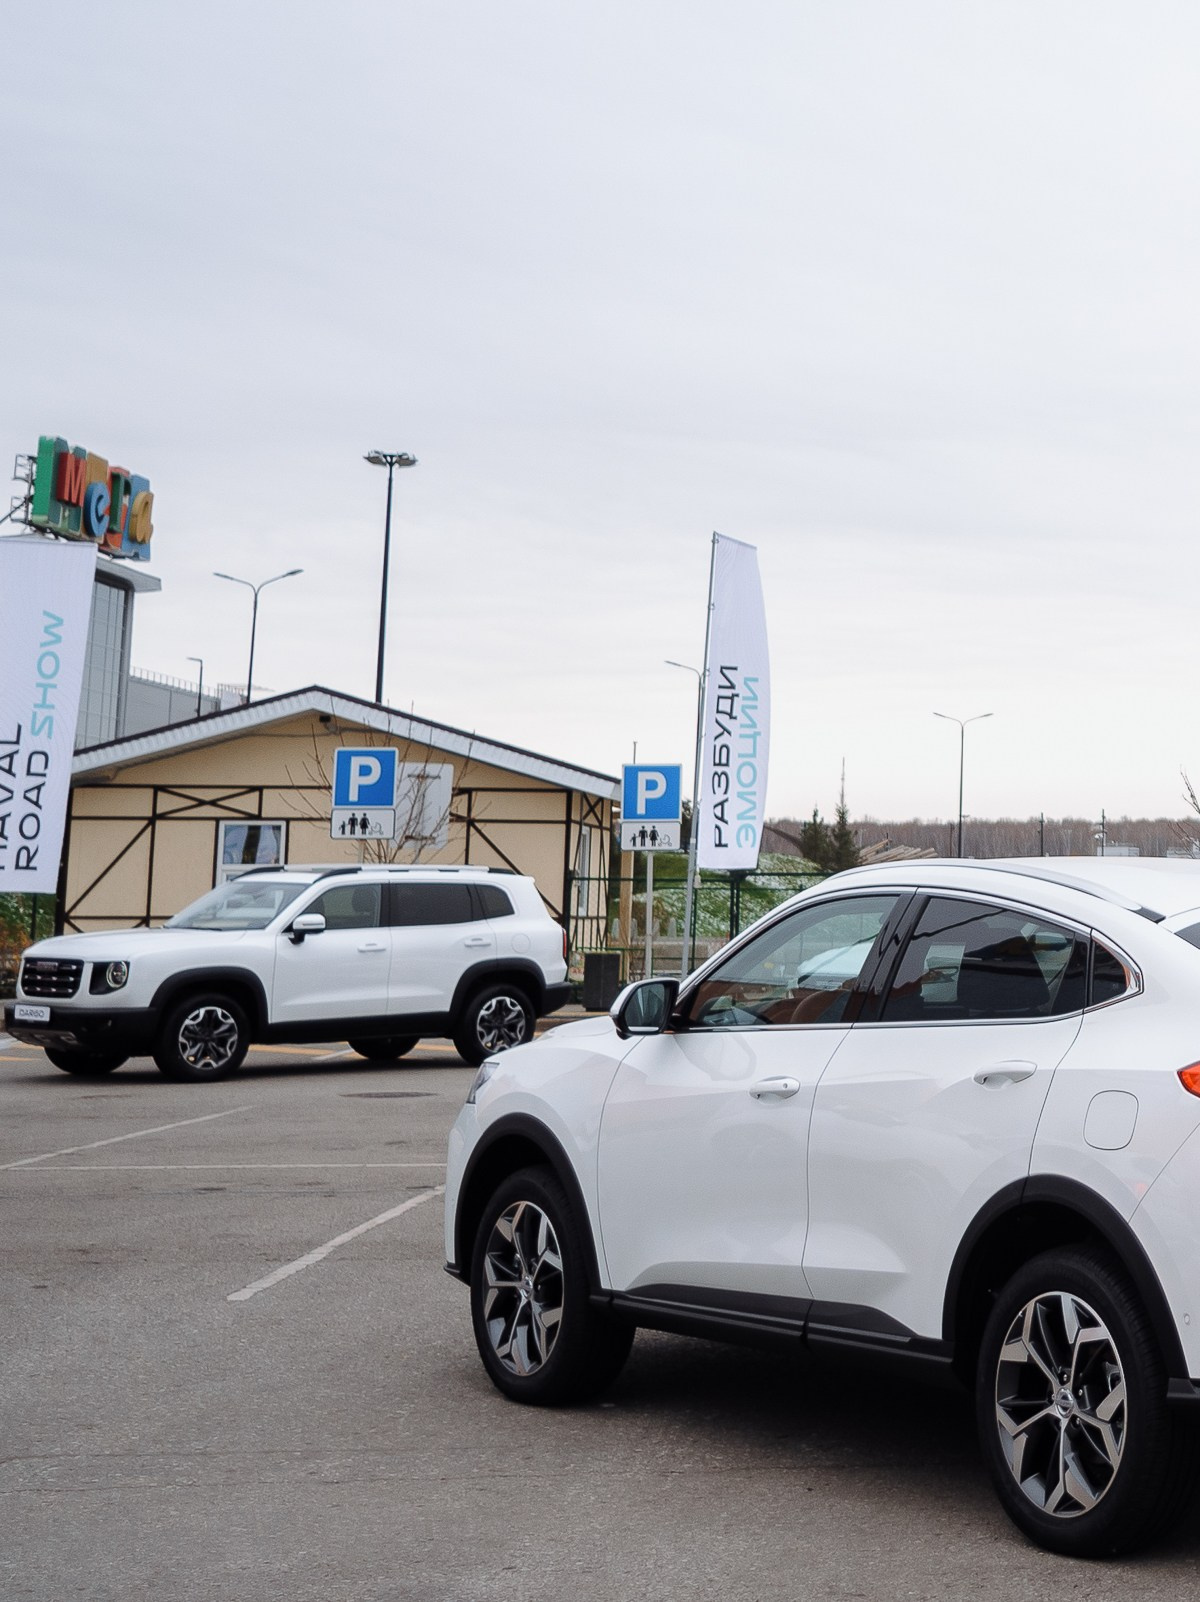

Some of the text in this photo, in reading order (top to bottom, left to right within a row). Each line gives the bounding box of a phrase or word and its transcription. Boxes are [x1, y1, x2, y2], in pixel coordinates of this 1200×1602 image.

[14, 609, 65, 871] ROAD SHOW
[348, 755, 382, 803] P
[636, 770, 667, 816] P
[711, 664, 740, 849] РАЗБУДИ
[735, 676, 762, 849] ЭМОЦИИ
